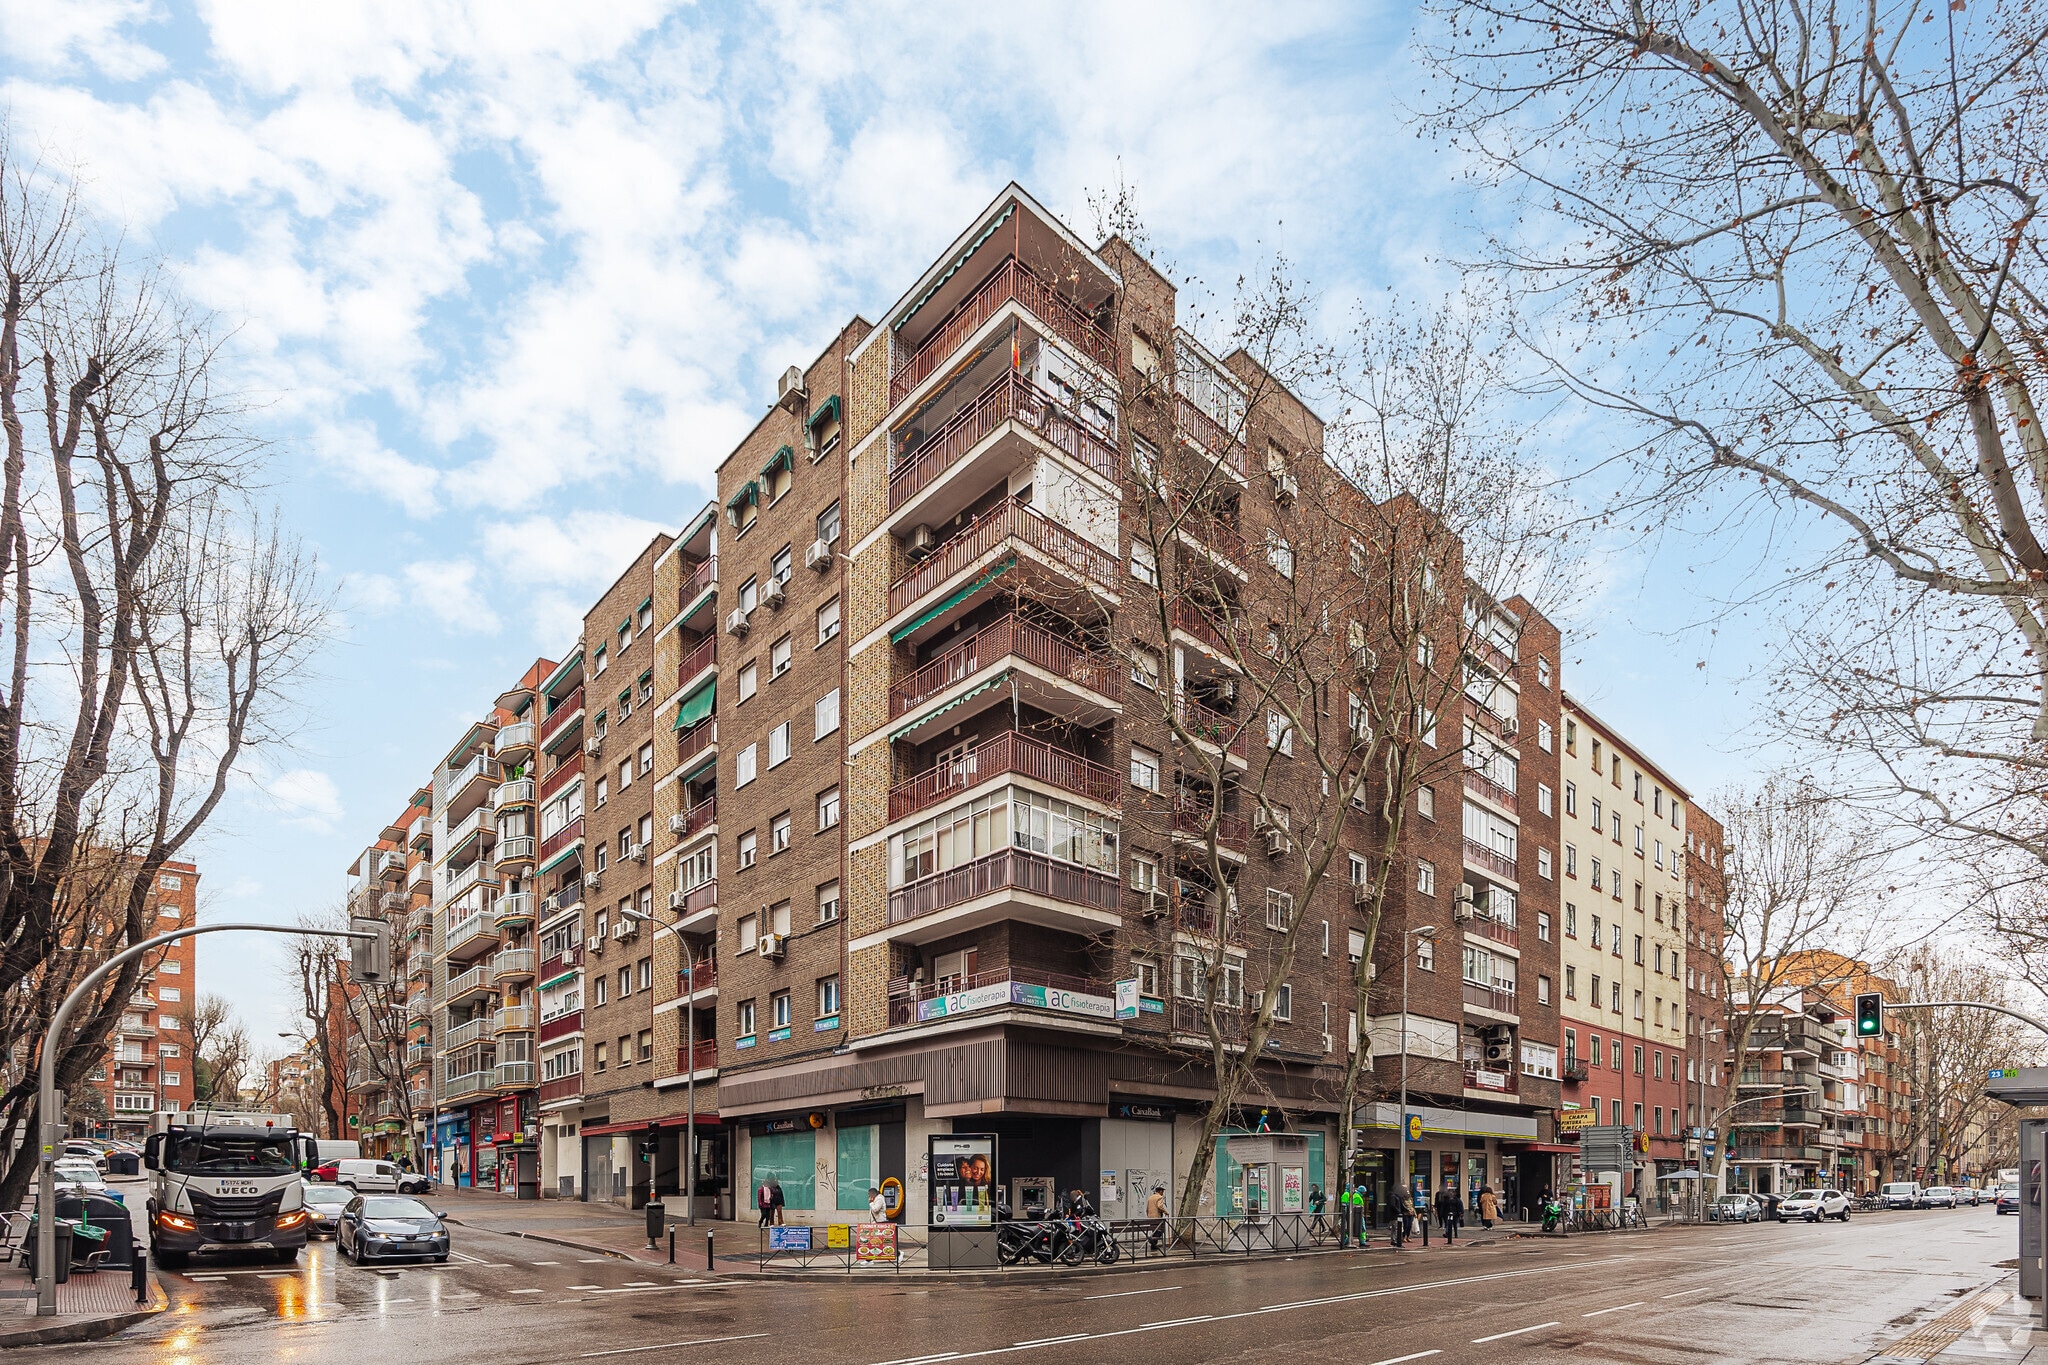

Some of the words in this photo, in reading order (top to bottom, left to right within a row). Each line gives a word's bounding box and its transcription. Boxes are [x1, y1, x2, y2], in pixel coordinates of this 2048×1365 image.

[950, 994, 967, 1012] ac
[967, 988, 1006, 1006] fisioterapia
[1051, 991, 1070, 1009] ac
[1071, 997, 1110, 1013] fisioterapia
[1131, 1105, 1162, 1117] CaixaBank
[215, 1187, 259, 1195] IVECO
